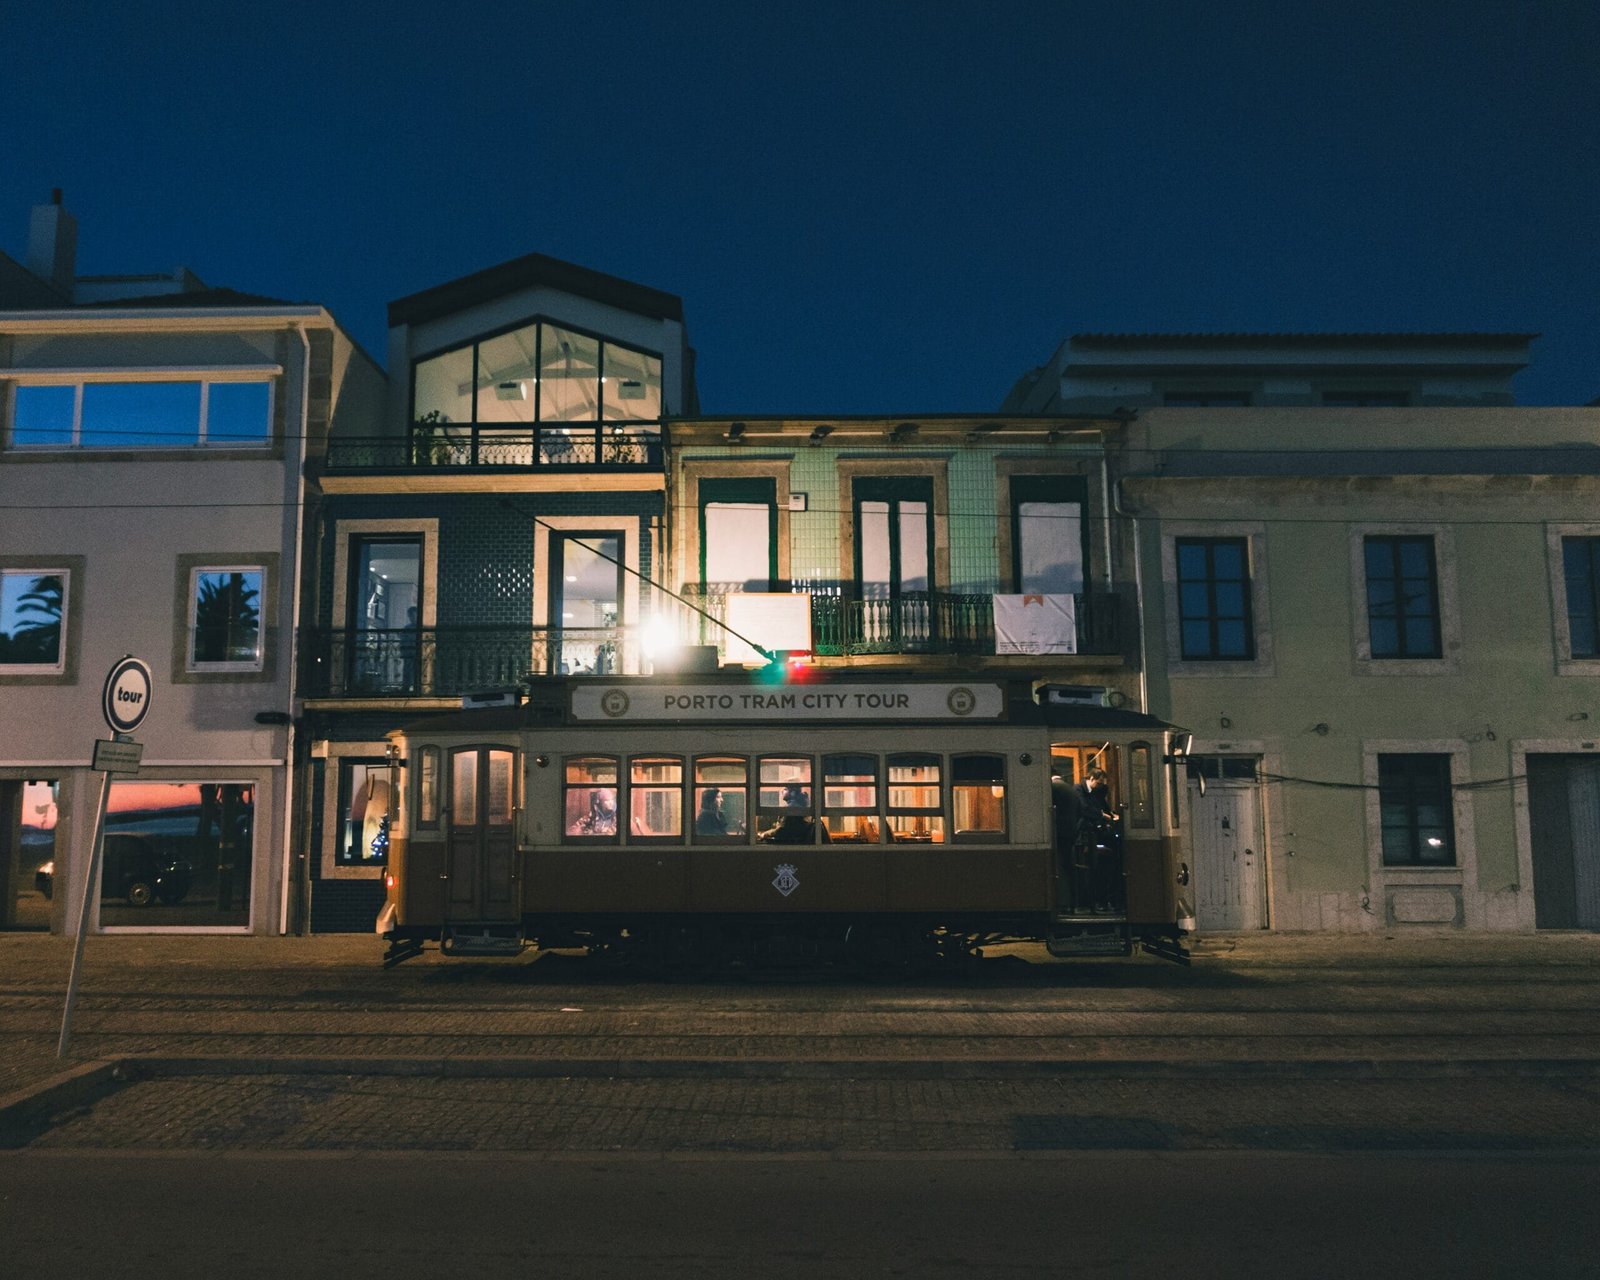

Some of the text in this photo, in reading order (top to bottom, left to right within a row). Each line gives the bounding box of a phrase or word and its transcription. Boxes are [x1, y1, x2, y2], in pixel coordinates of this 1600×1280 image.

[117, 686, 143, 704] tour
[664, 693, 909, 709] PORTO TRAM CITY TOUR
